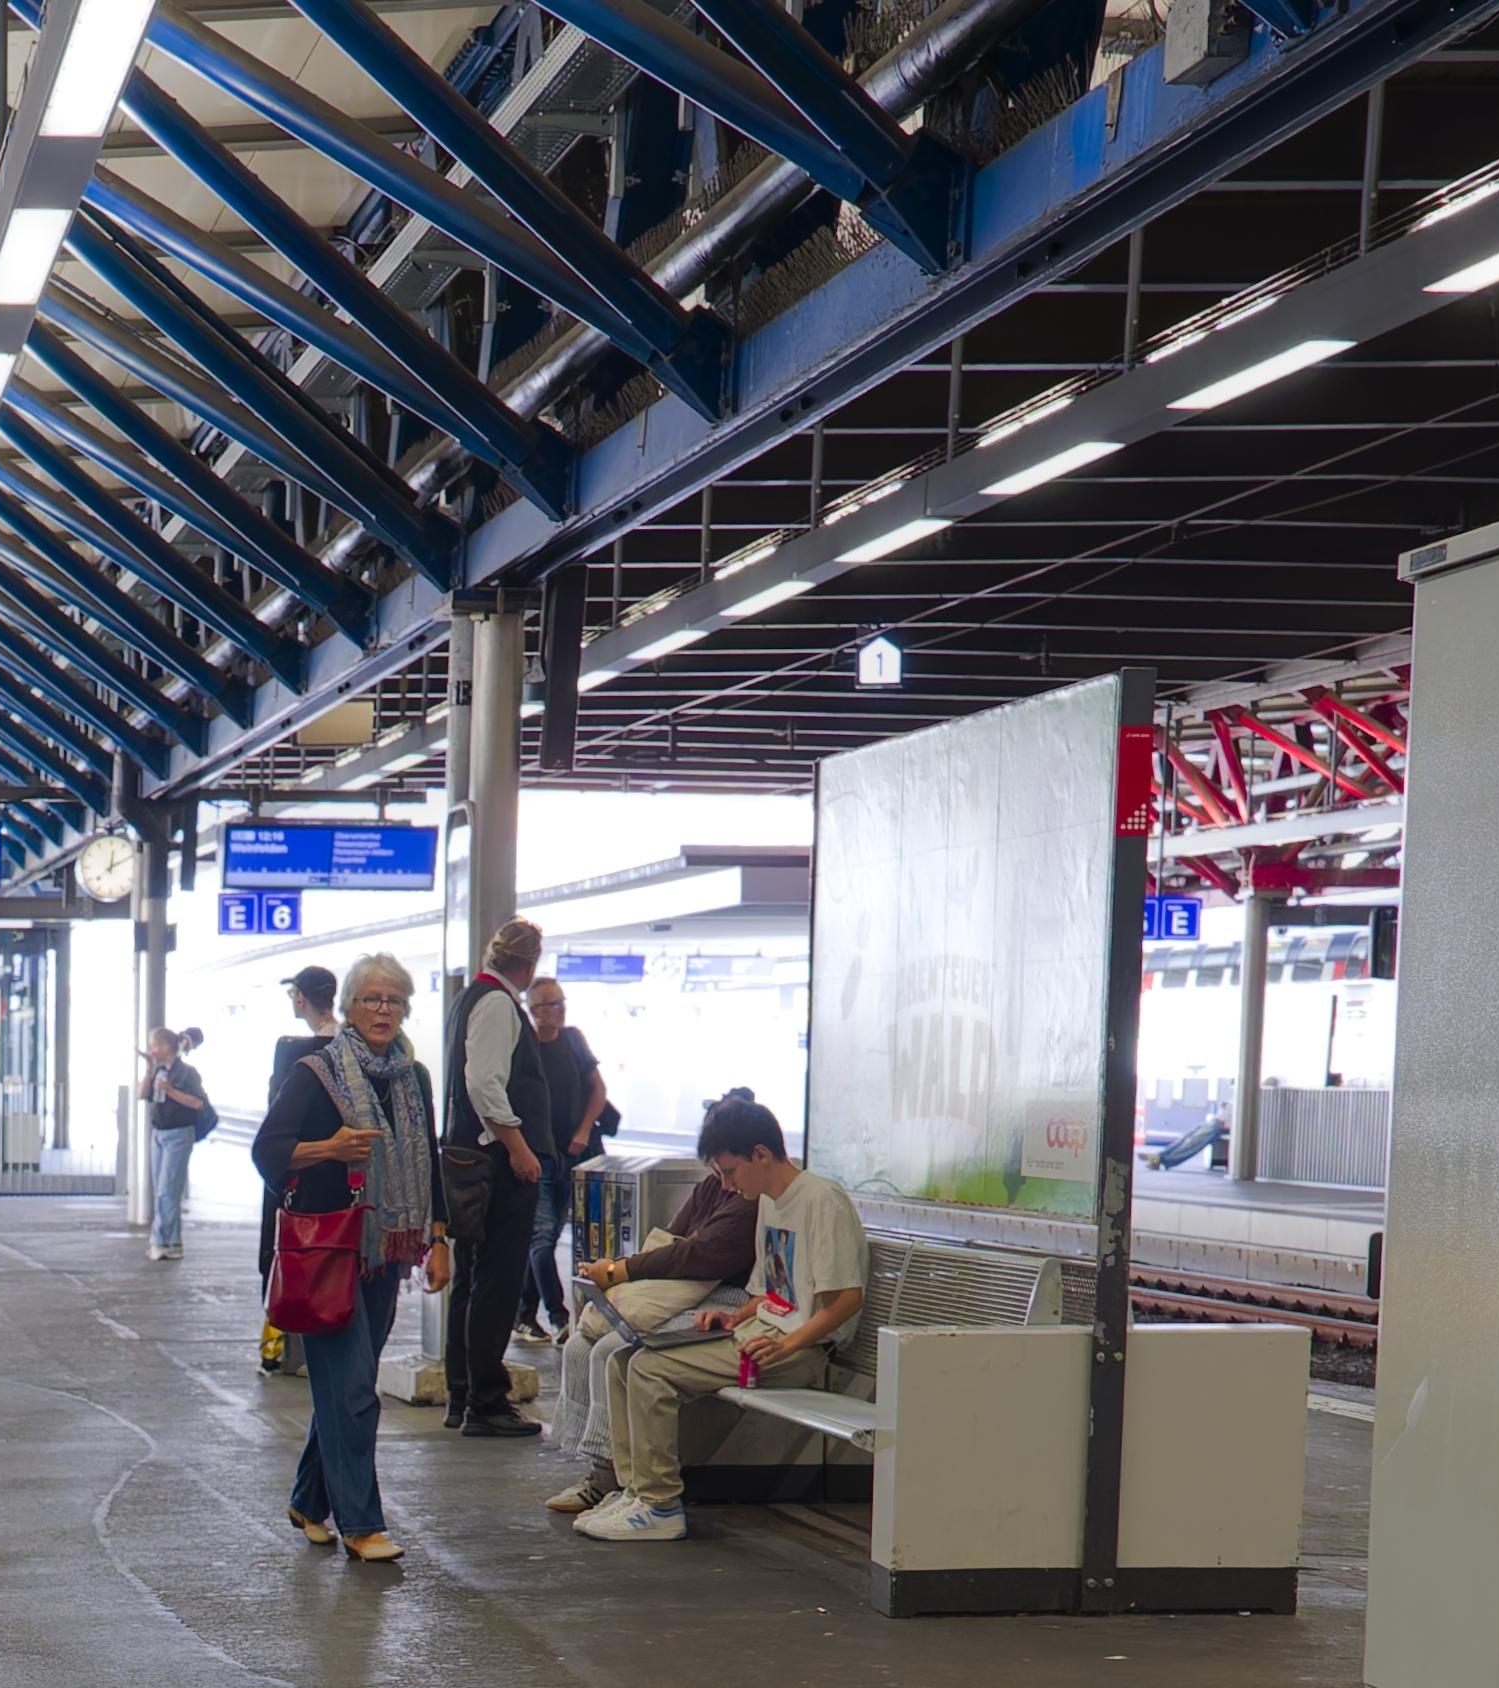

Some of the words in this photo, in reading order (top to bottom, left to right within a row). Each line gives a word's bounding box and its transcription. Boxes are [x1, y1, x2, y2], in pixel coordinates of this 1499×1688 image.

[875, 652, 883, 677] 1
[228, 905, 247, 930] E
[272, 904, 292, 930] 6
[1171, 910, 1189, 935] E
